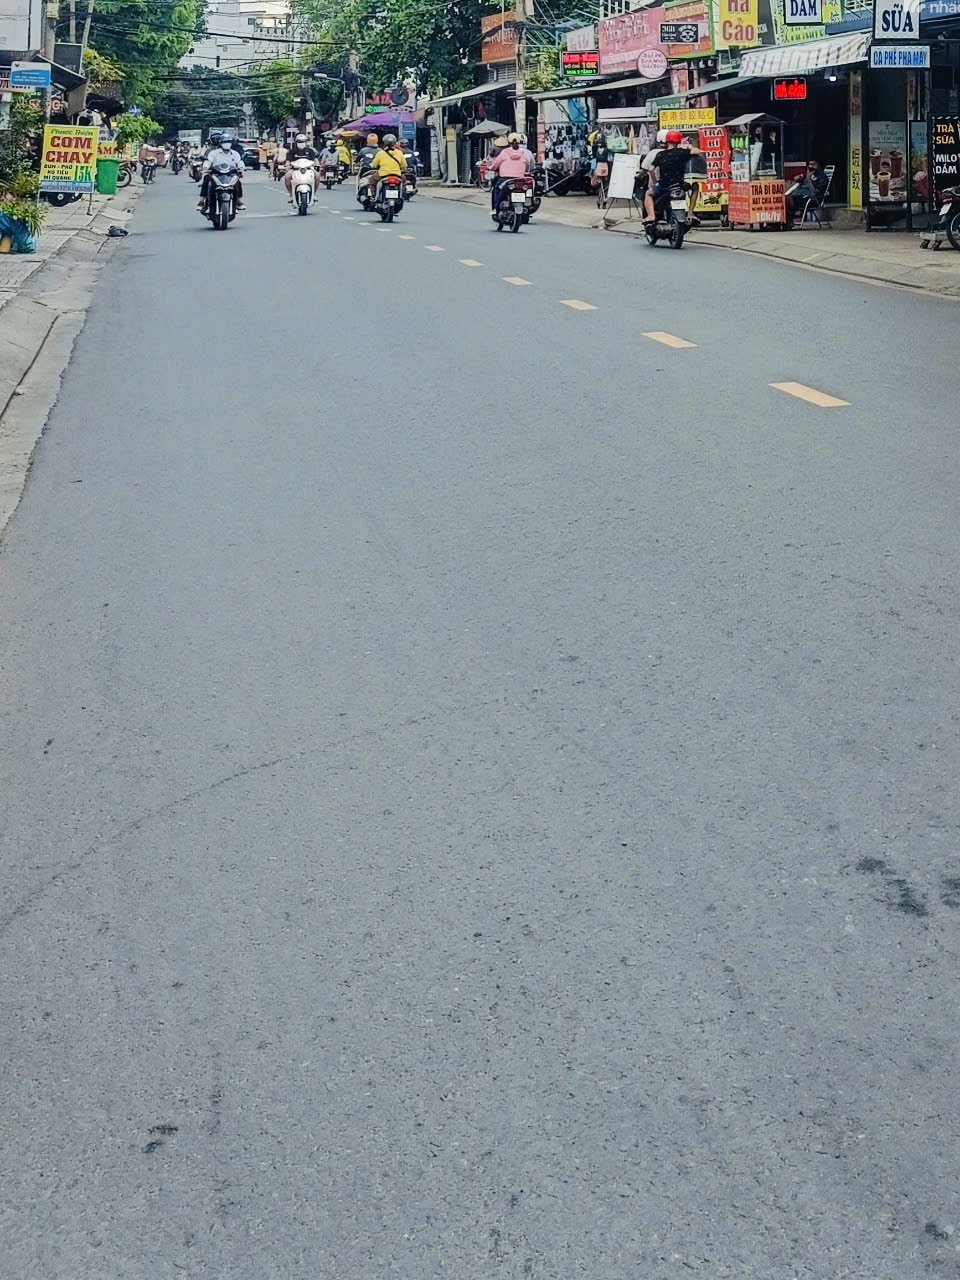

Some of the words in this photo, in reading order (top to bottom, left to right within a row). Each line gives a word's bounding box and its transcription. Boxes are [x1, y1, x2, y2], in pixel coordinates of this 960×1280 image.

[881, 3, 914, 33] SỮA
[722, 17, 755, 42] Cảo
[898, 50, 912, 66] PHA
[935, 122, 955, 133] TRÀ
[50, 135, 93, 149] CƠM
[935, 134, 956, 145] SỮA
[45, 150, 94, 164] CHAY
[935, 153, 958, 163] MILO
[706, 171, 726, 179] HIA
